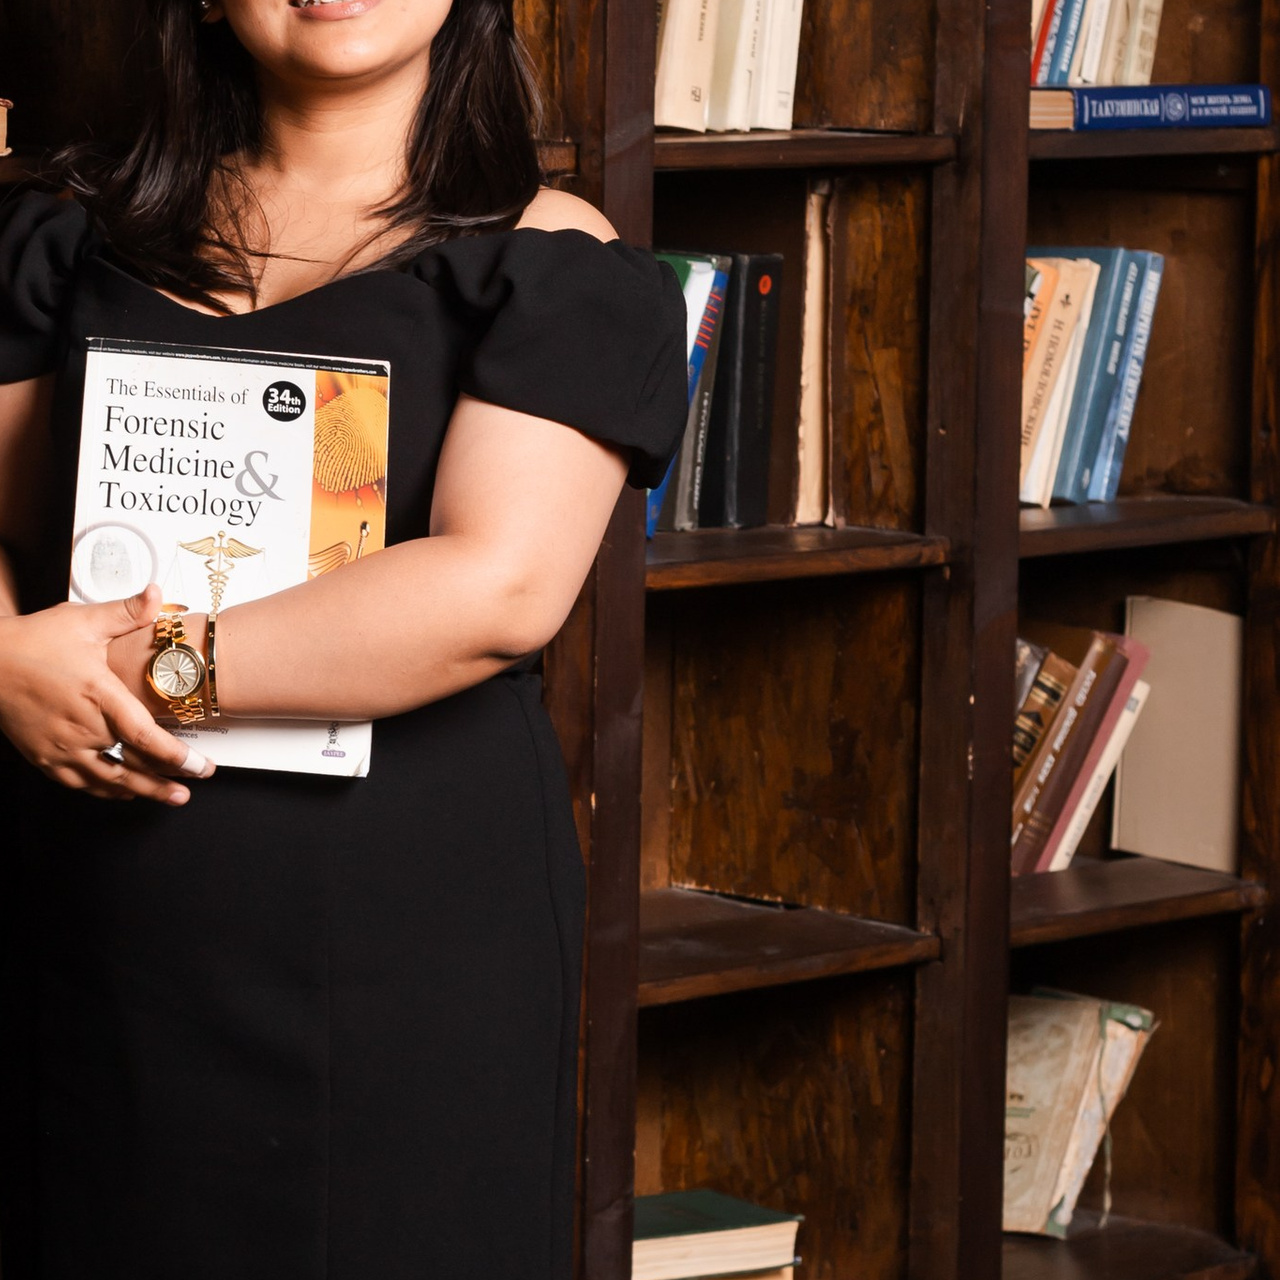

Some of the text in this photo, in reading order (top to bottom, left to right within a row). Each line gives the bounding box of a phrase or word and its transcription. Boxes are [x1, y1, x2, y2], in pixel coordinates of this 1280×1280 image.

[106, 378, 250, 406] The Essentials of
[267, 388, 301, 406] 34th
[1117, 357, 1145, 443] АЛЕКСАНДР
[104, 405, 225, 441] Forensic
[267, 403, 301, 415] Edition
[100, 443, 286, 501] Medicine &
[98, 480, 263, 527] Toxicology
[170, 730, 199, 739] Sciences
[195, 725, 230, 735] Toxicology
